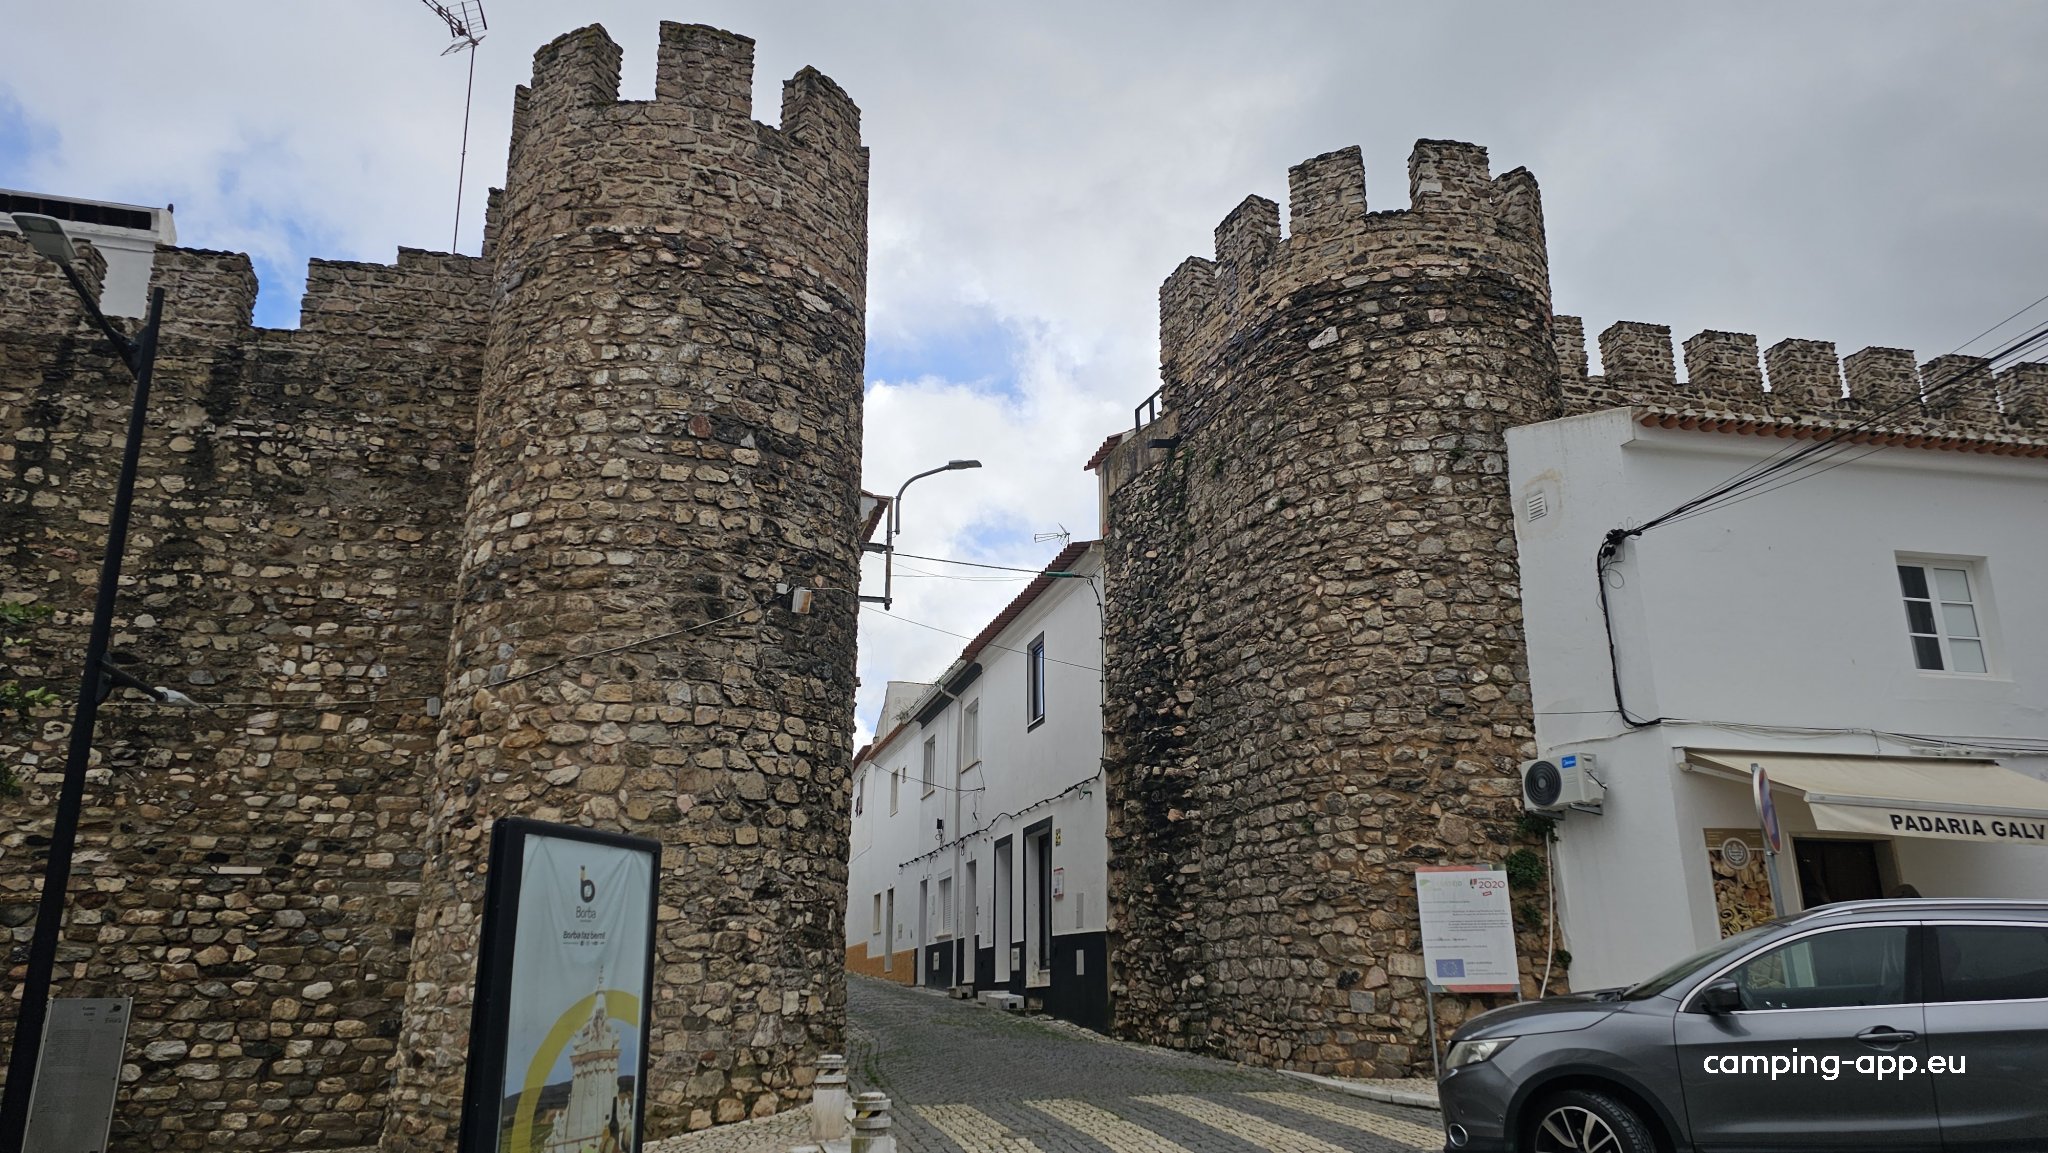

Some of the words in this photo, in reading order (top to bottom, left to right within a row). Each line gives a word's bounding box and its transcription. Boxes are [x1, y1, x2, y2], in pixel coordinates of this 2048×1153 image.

[1889, 814, 1986, 836] PADARIA
[1991, 821, 2045, 840] GALV
[1478, 880, 1506, 889] 2020
[576, 905, 597, 919] Borba
[563, 930, 581, 940] Borba
